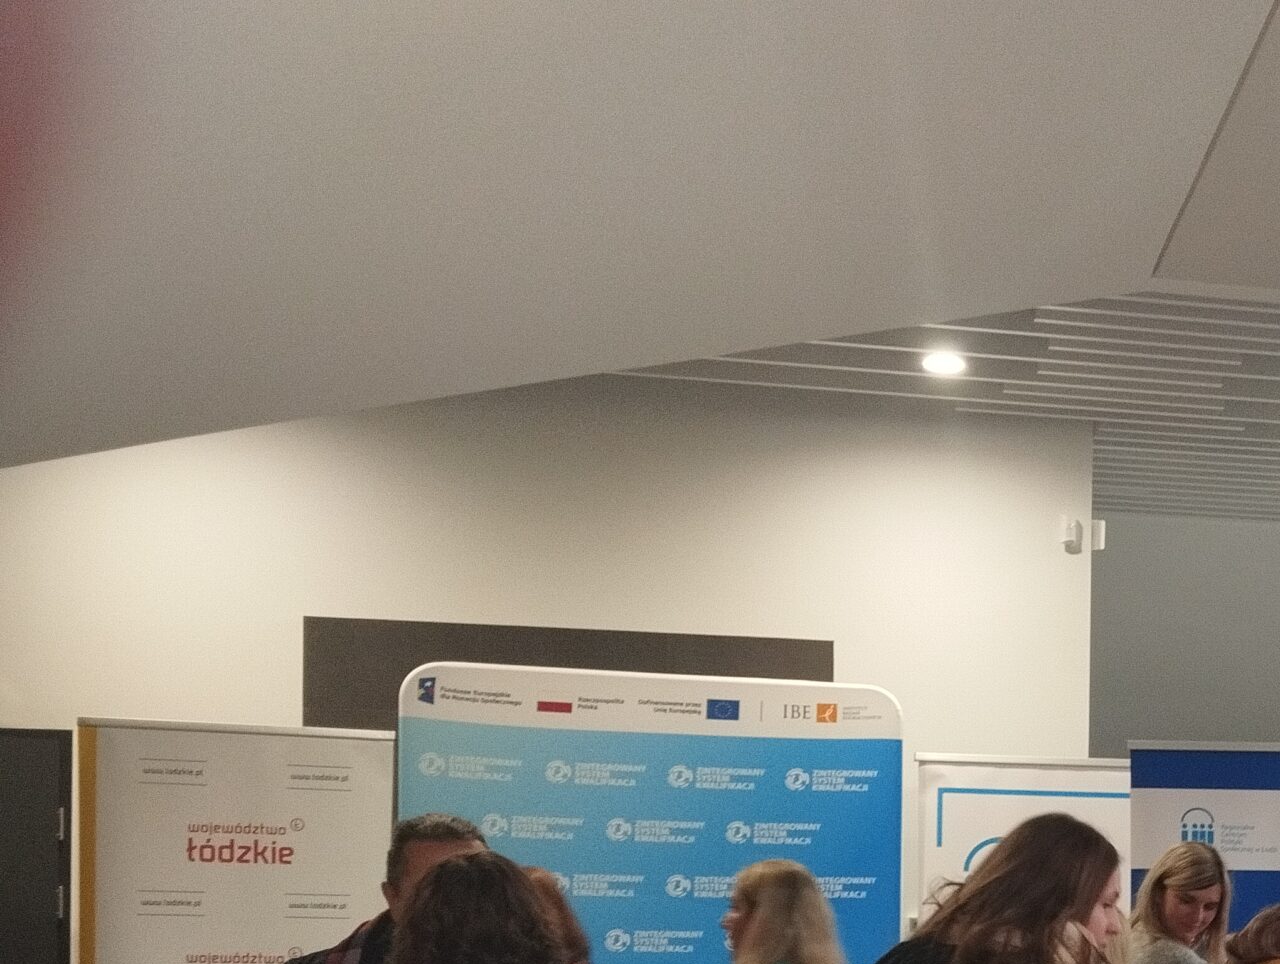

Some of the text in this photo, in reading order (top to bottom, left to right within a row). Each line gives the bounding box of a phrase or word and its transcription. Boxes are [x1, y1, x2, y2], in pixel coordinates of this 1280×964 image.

[783, 703, 812, 719] IBE
[187, 821, 287, 837] województwo
[186, 838, 295, 865] łódzkie
